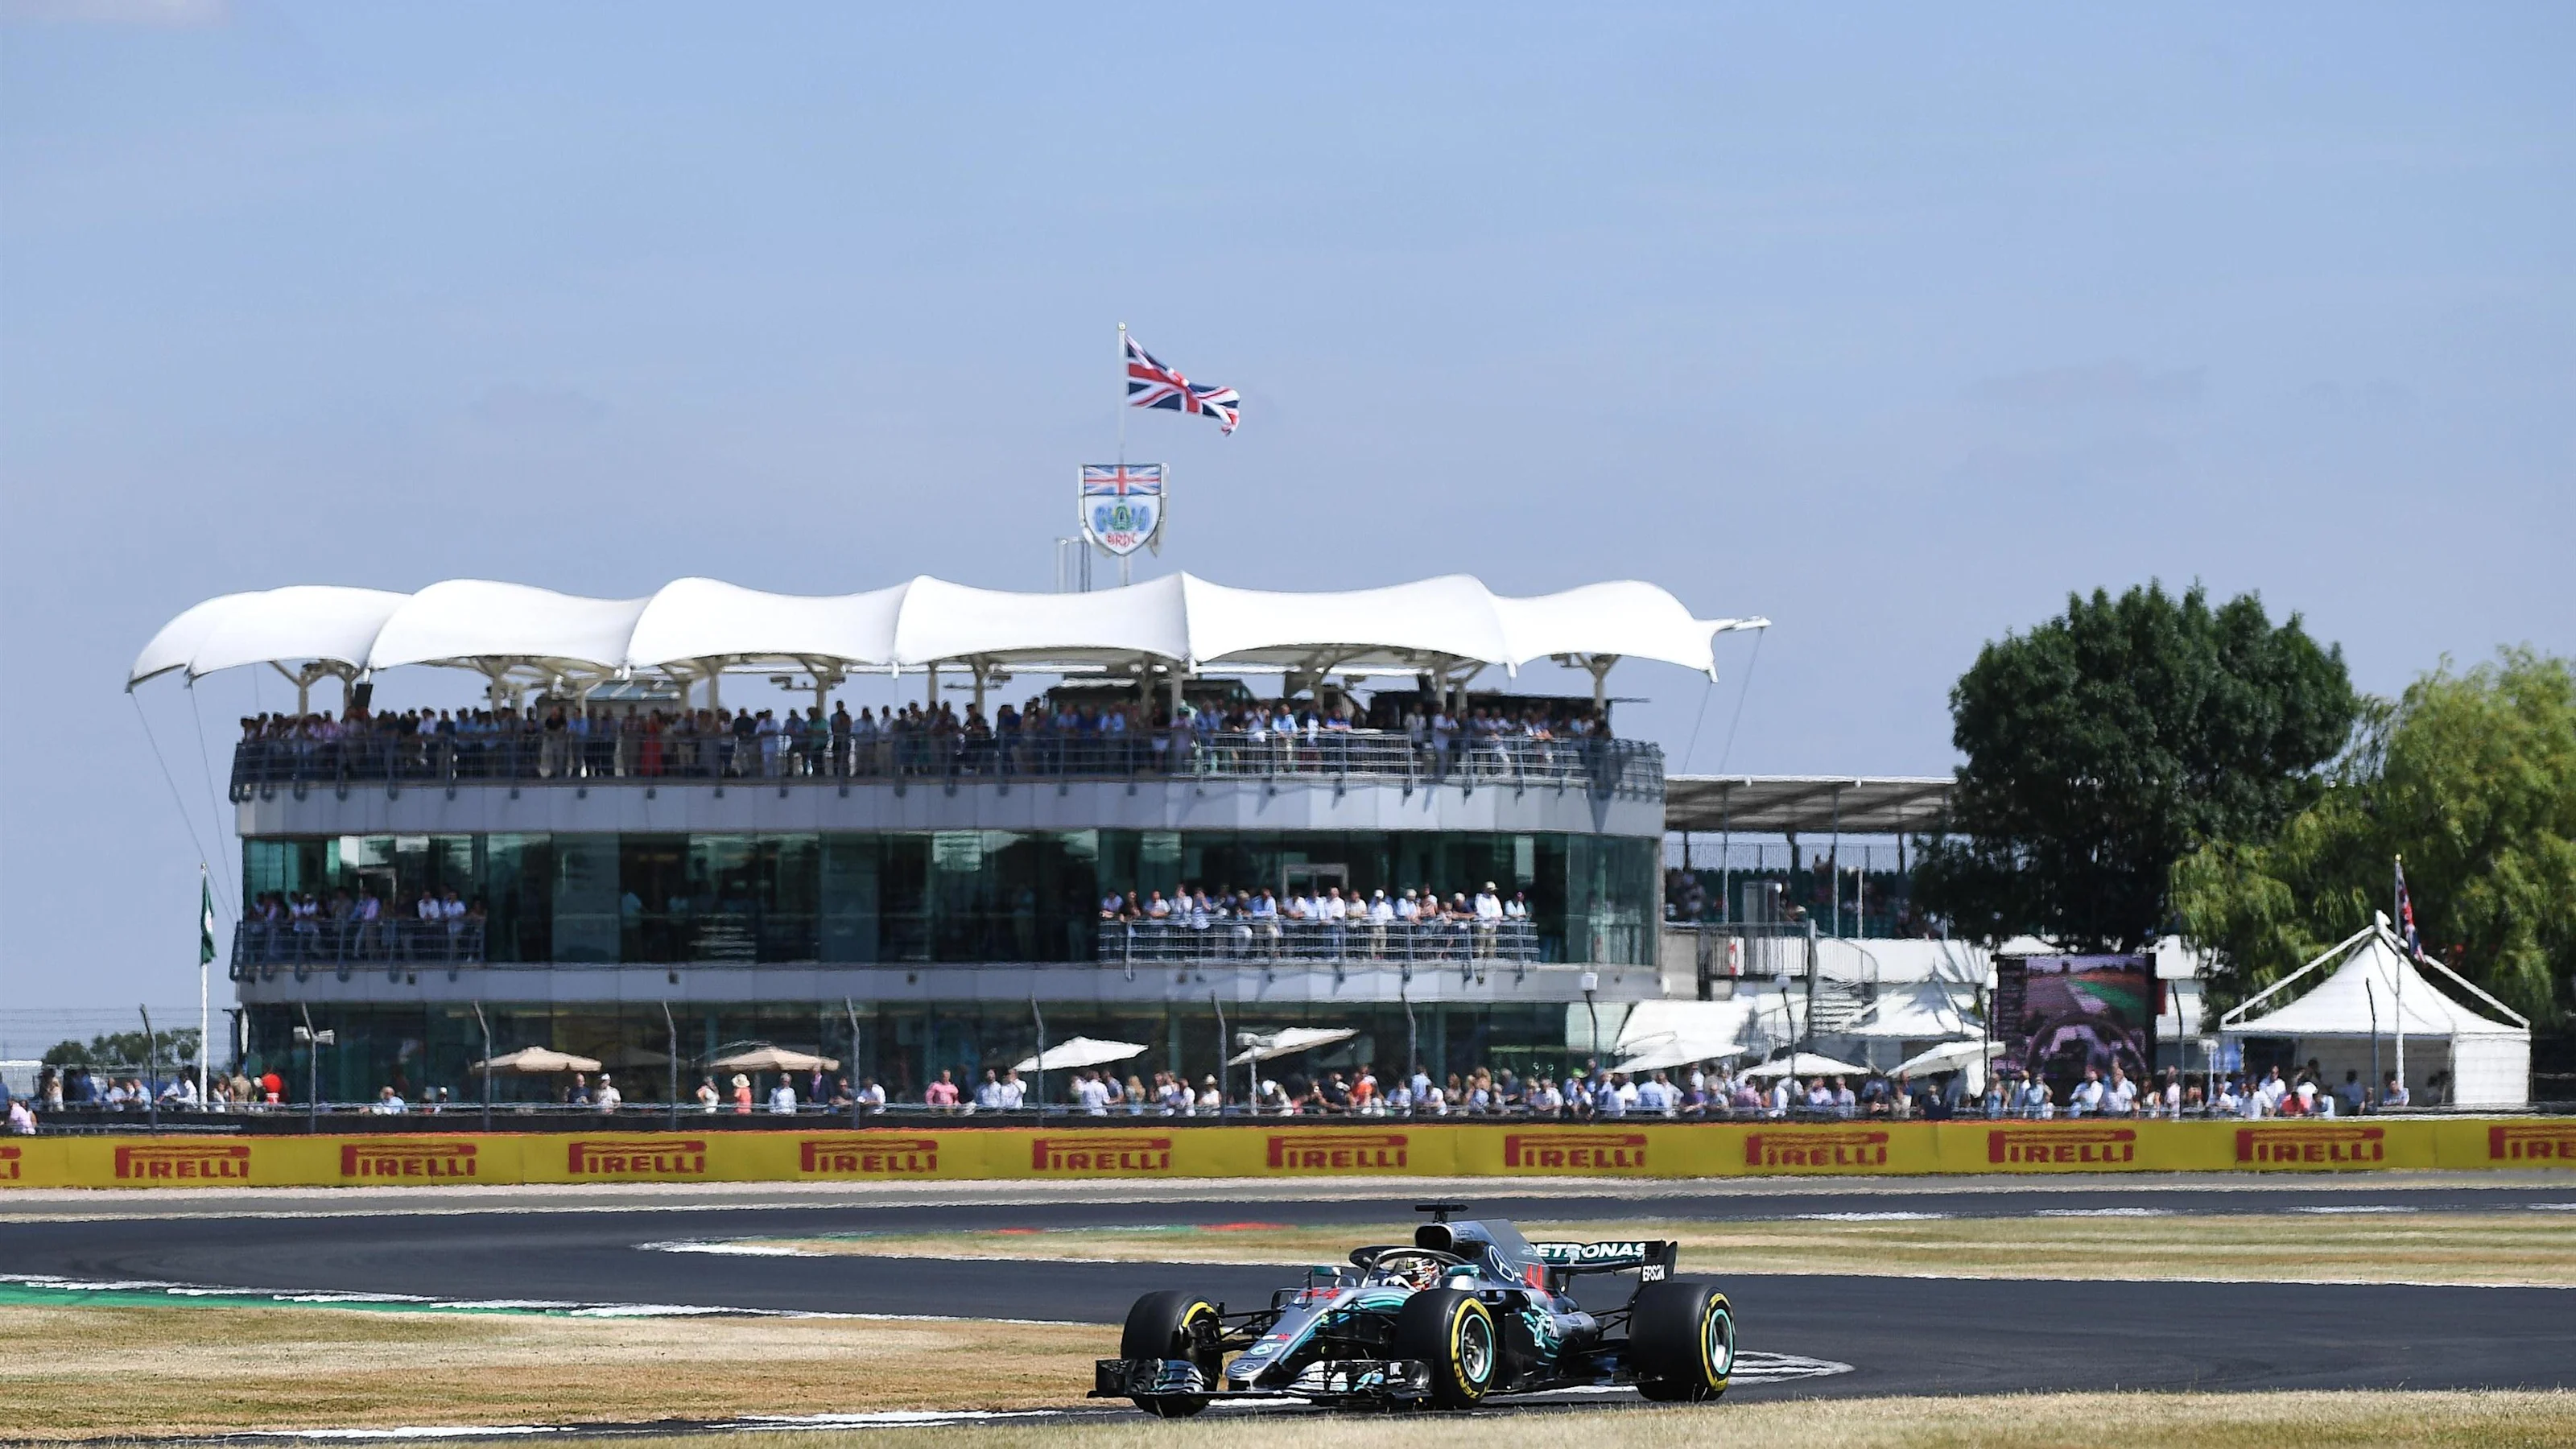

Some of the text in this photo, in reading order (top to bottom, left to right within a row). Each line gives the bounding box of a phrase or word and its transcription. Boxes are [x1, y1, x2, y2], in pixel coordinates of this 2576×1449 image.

[1107, 532, 1137, 547] BRDC
[341, 1144, 477, 1175] PIRELLI
[568, 1140, 706, 1173] PIRELLI
[801, 1140, 938, 1171] PIRELLI
[1032, 1137, 1170, 1170] PIRELLI
[1268, 1135, 1407, 1167] PIRELLI
[1505, 1133, 1647, 1167] PIRELLI
[1746, 1132, 1889, 1165] PIRELLI
[1988, 1129, 2136, 1162] PIRELLI
[2235, 1127, 2384, 1161] PIRELLI
[115, 1145, 250, 1178] PIRELLI
[1642, 1265, 1666, 1282] EPSON
